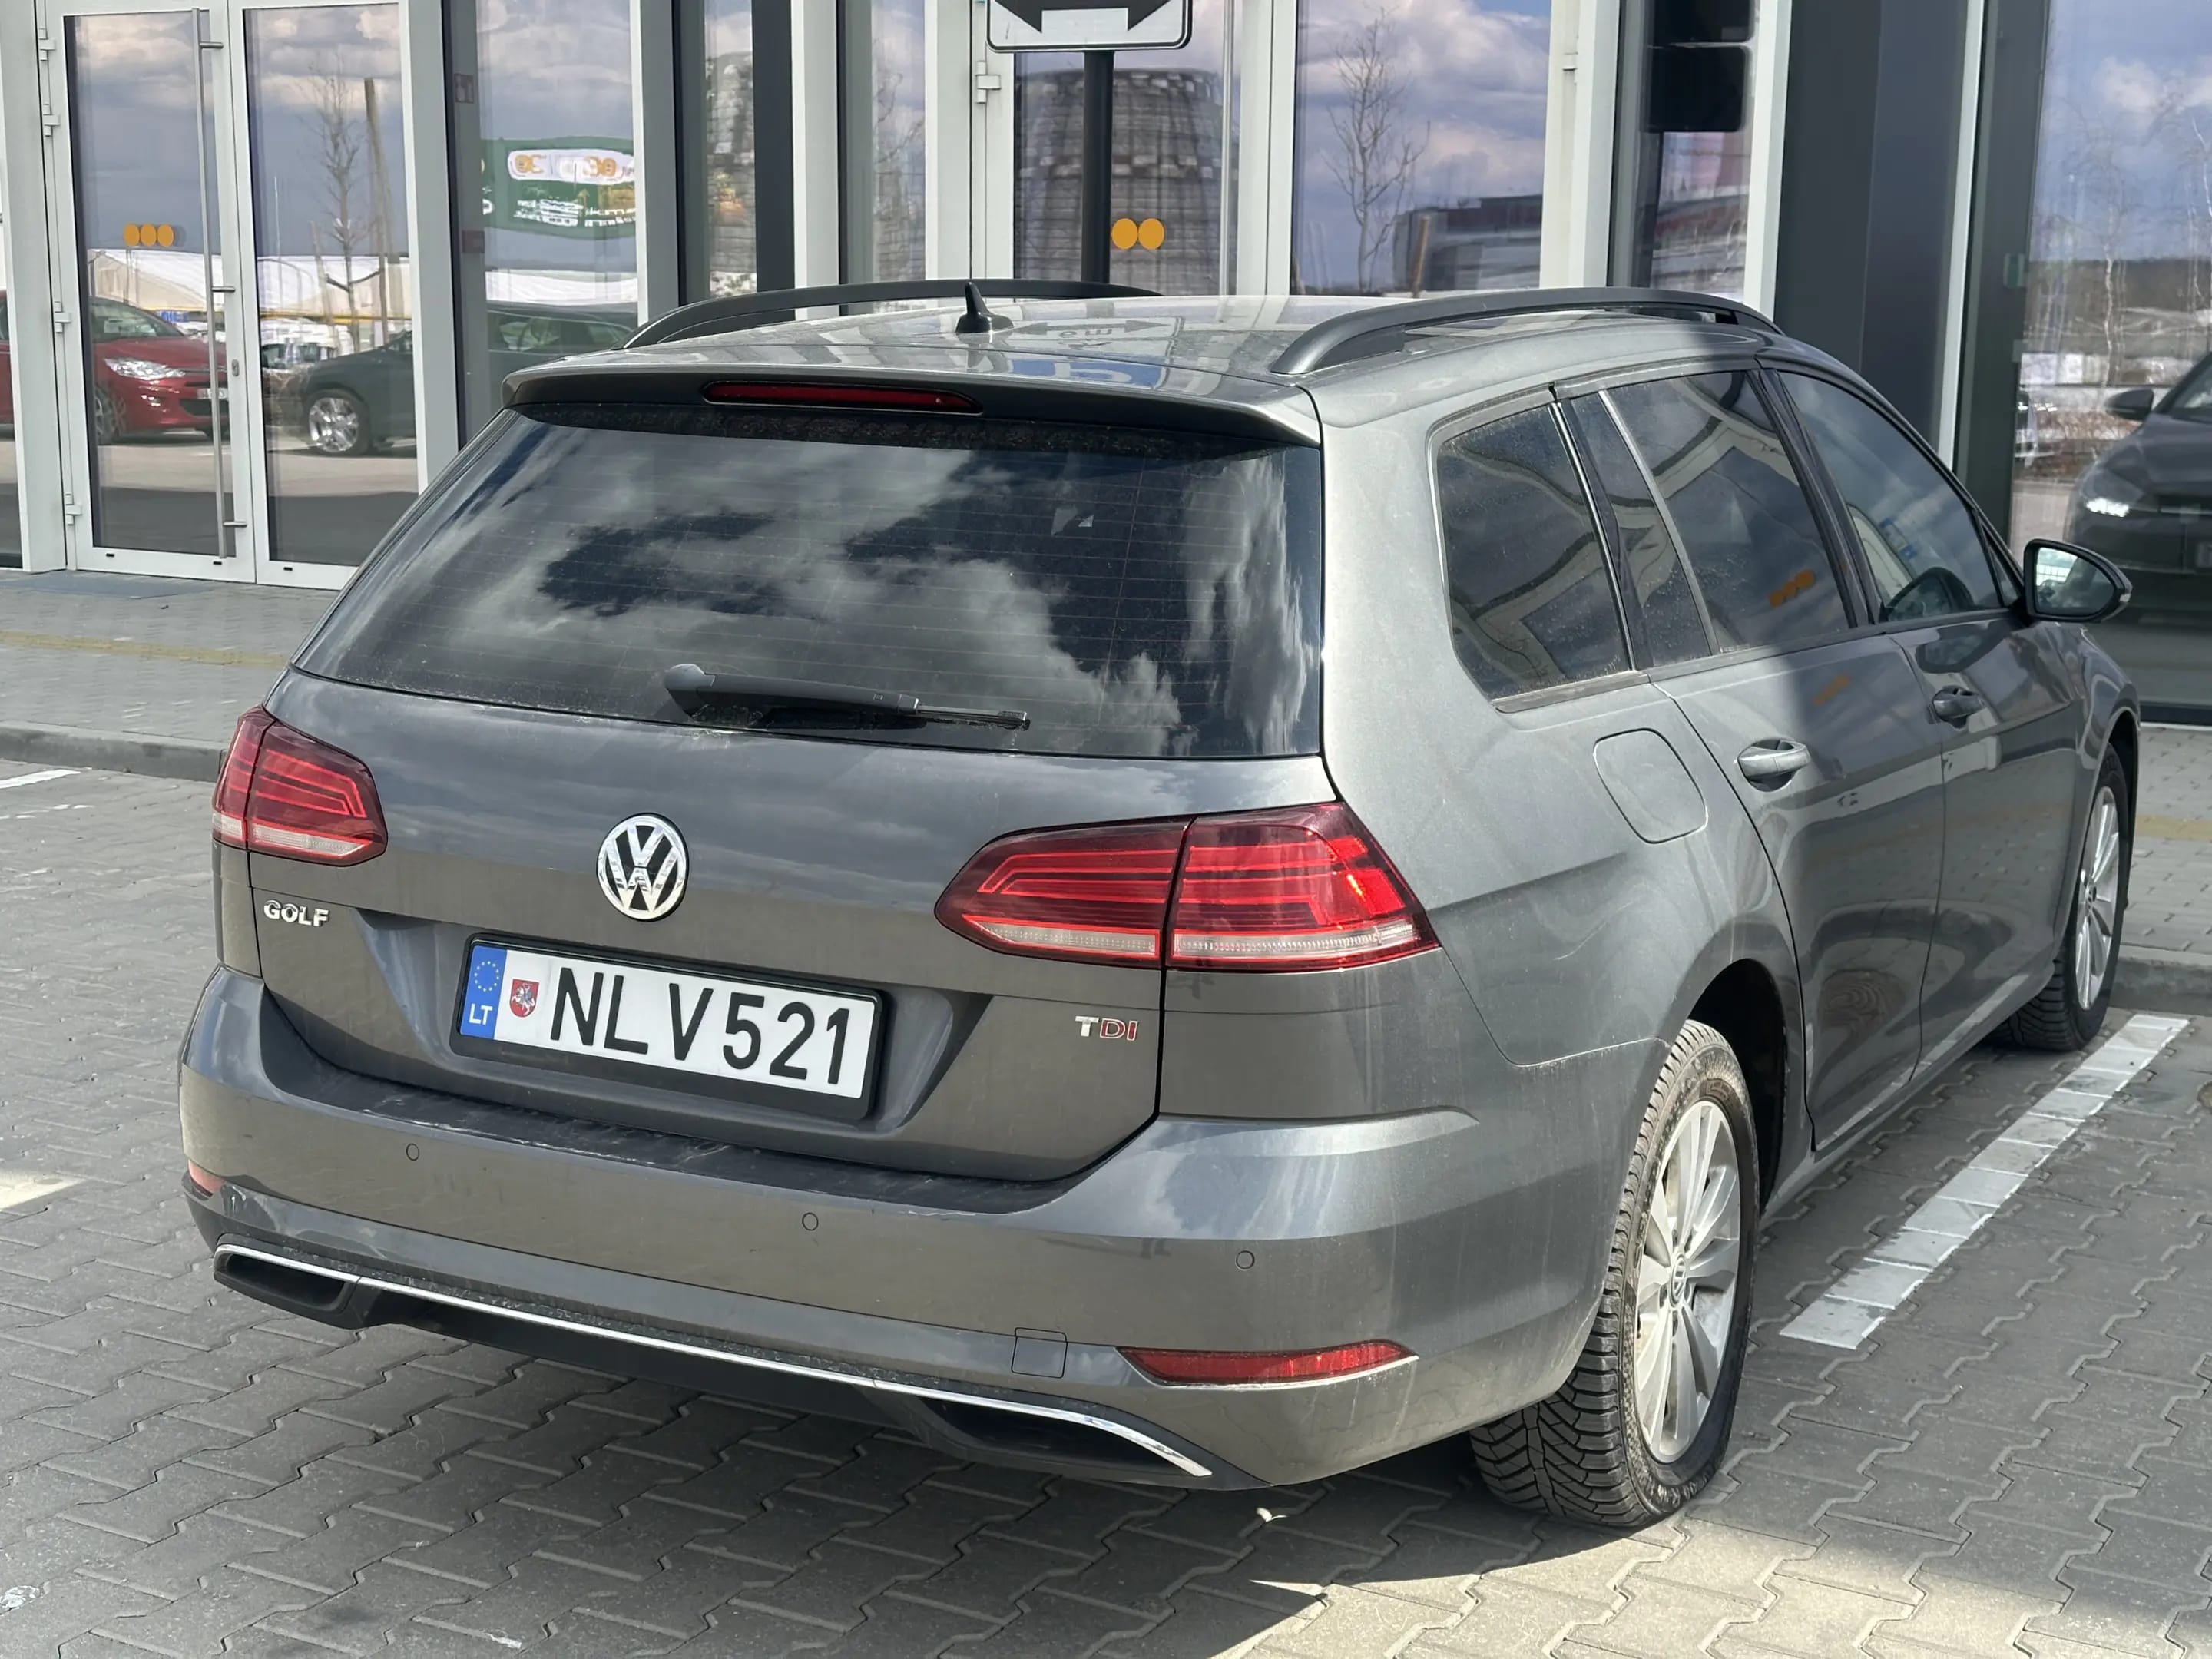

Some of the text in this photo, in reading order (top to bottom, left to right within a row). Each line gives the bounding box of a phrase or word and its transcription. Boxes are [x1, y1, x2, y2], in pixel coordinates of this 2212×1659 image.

[598, 815, 687, 920] VW
[263, 899, 329, 926] GOLF
[469, 1004, 493, 1026] LT
[1075, 1015, 1138, 1041] TDI
